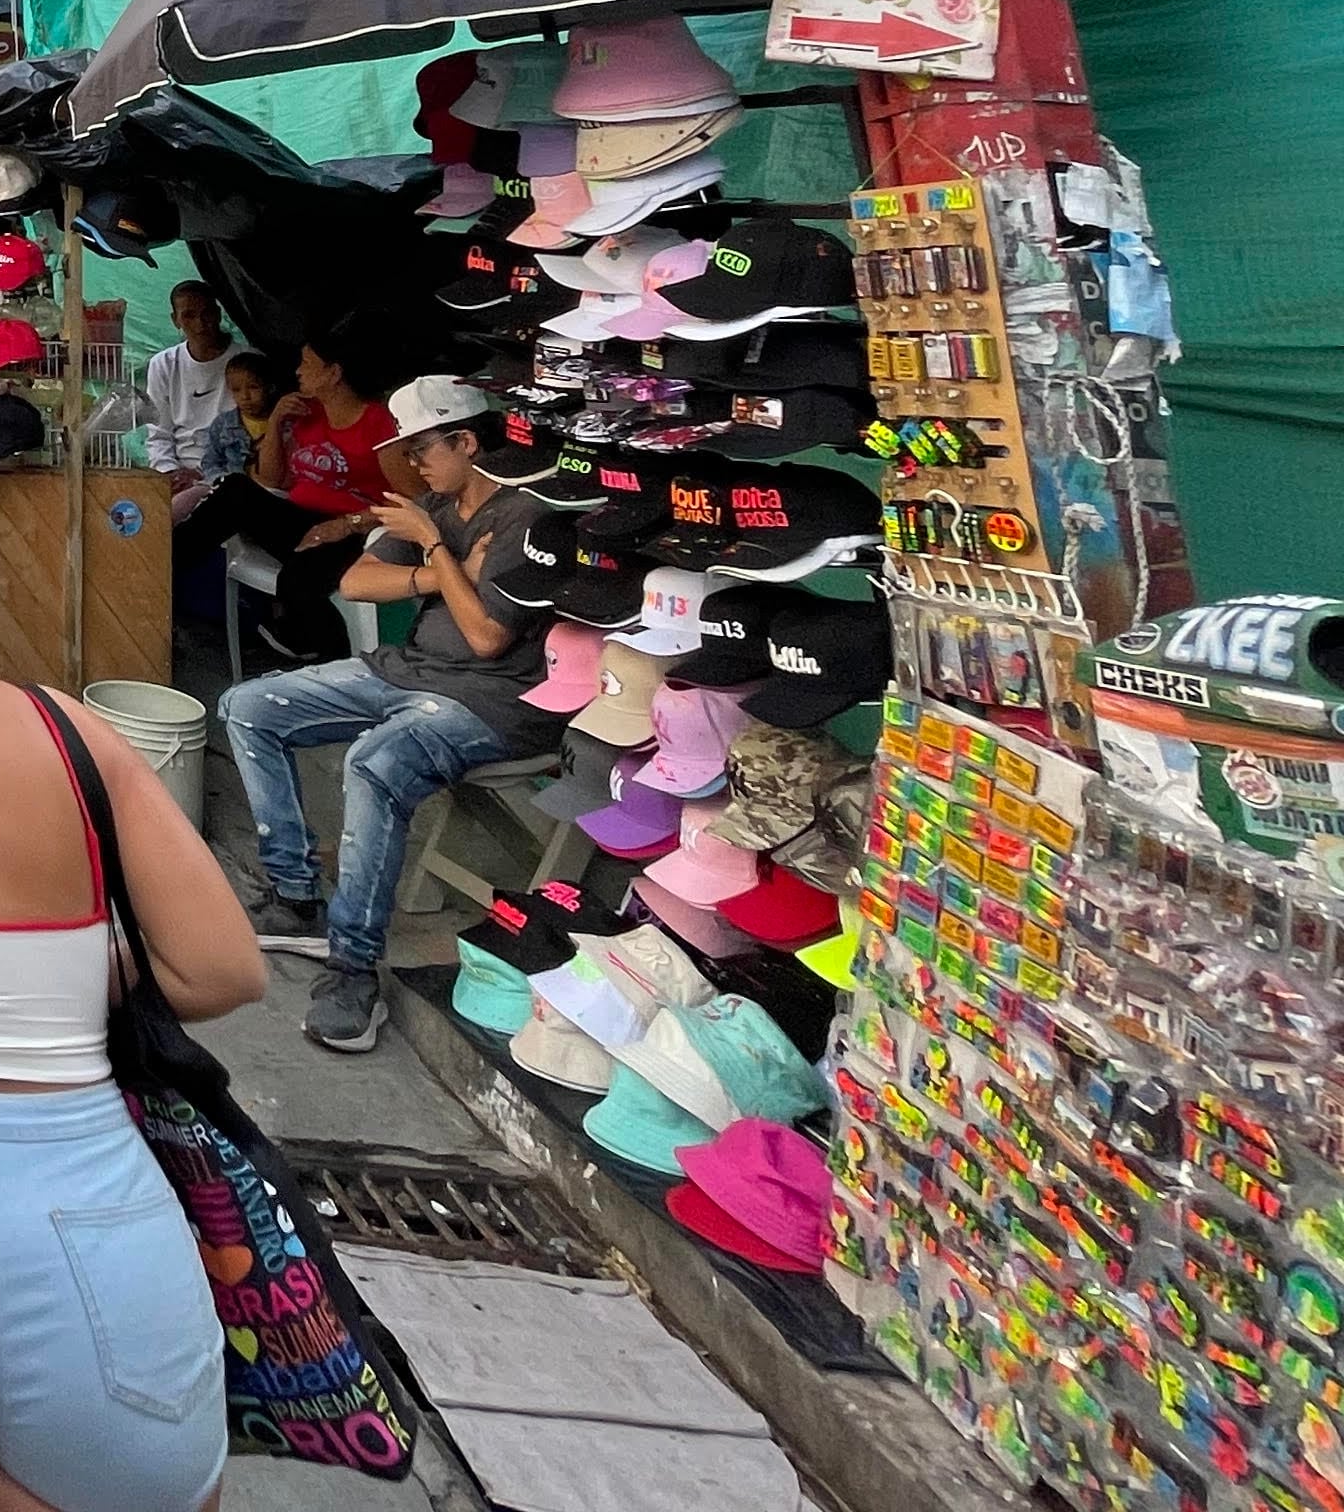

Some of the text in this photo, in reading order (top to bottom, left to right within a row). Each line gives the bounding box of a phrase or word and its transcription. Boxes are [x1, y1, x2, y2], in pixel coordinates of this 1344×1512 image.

[1099, 660, 1205, 705] CHEKS
[143, 1095, 197, 1124] RIO
[143, 1117, 213, 1149] SUMMER
[221, 1159, 288, 1274] JANEIRO
[278, 1409, 402, 1469] RIO
